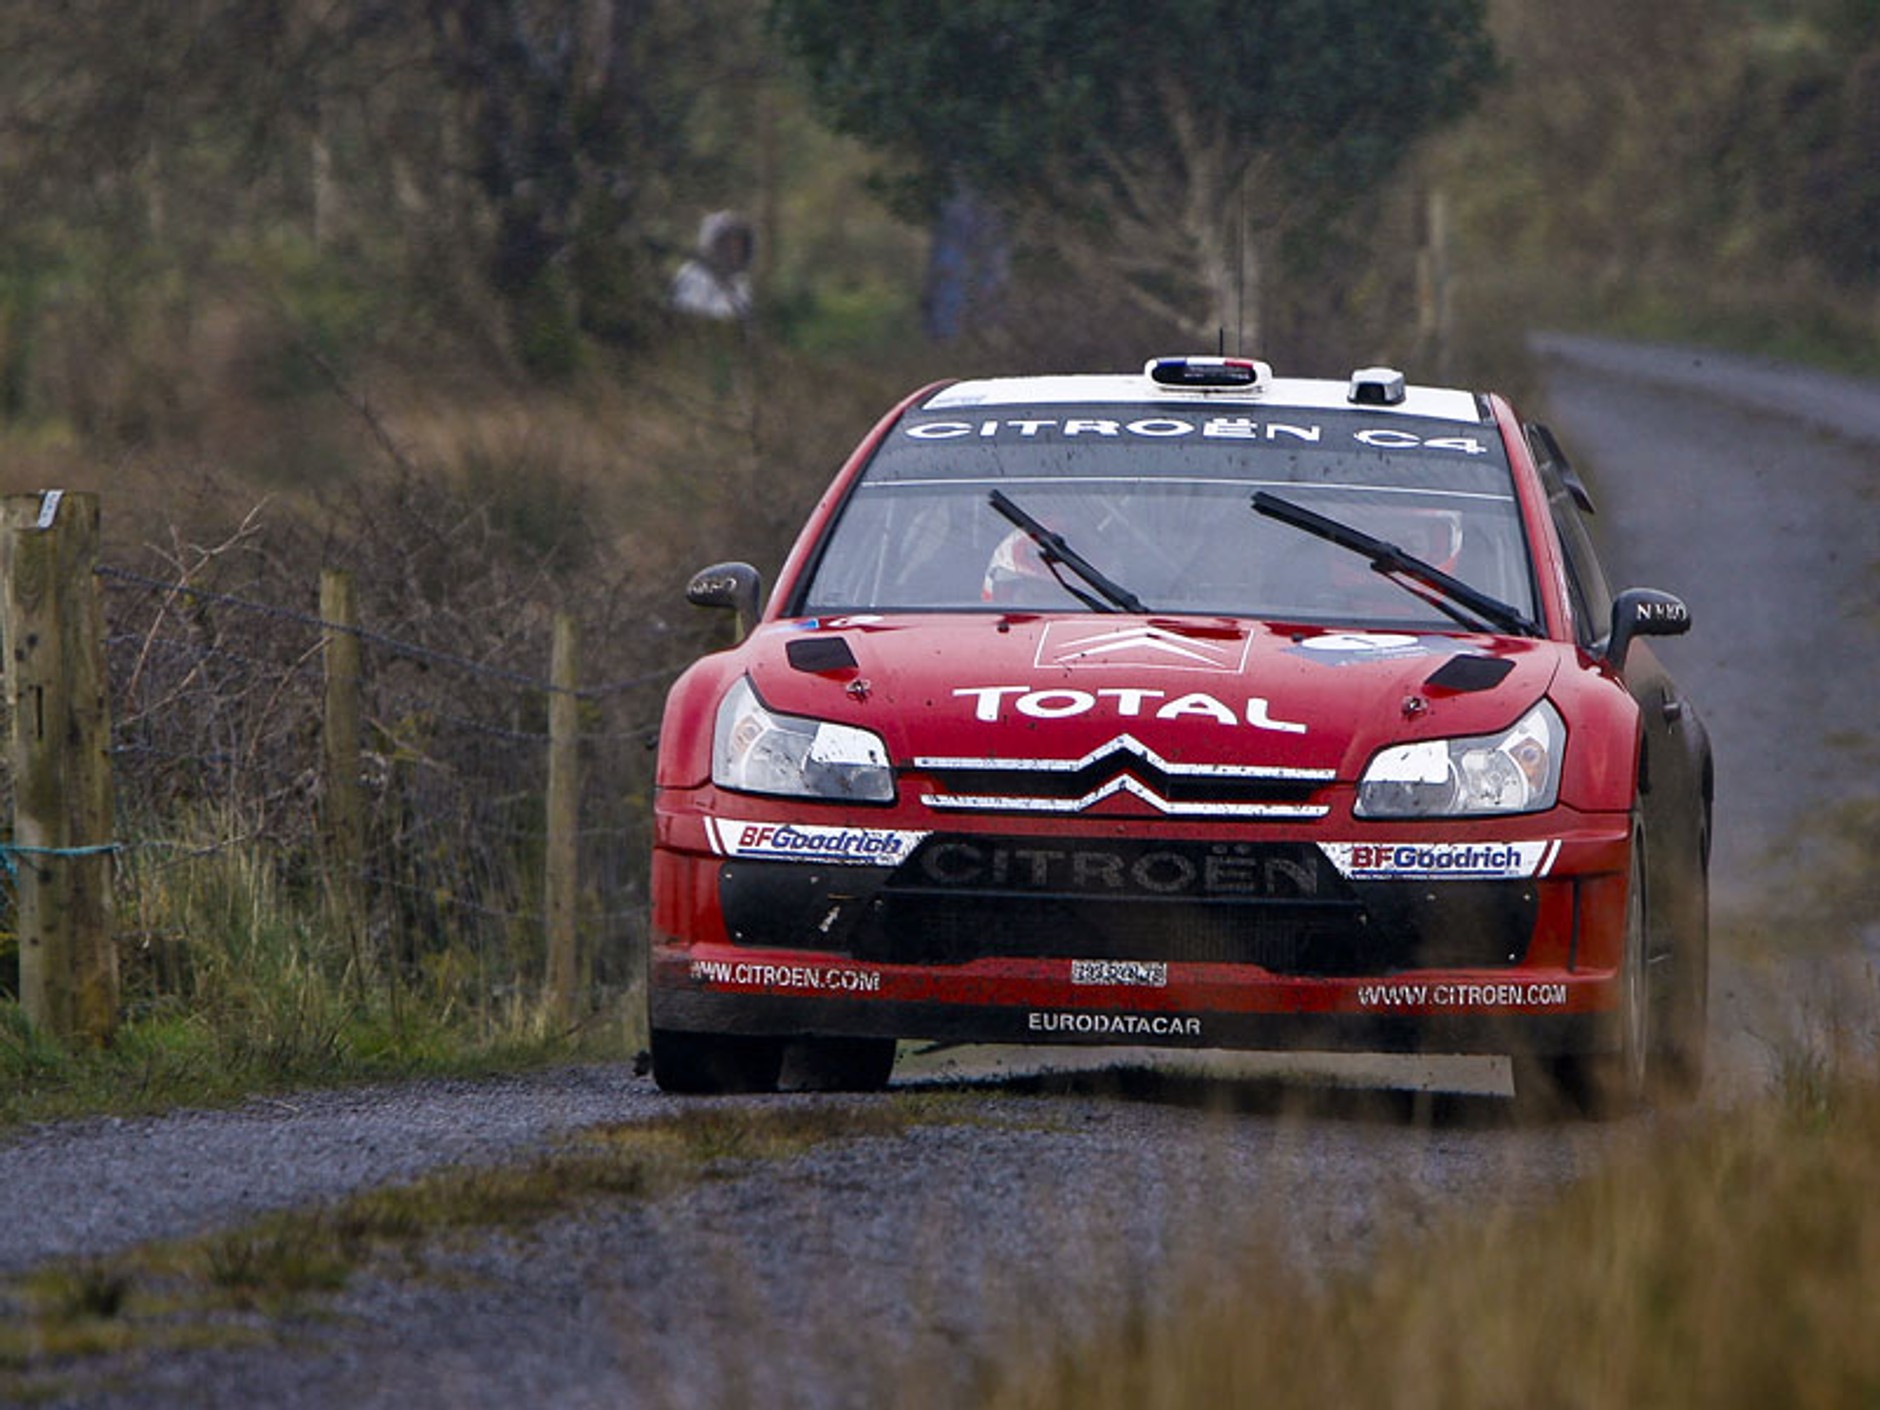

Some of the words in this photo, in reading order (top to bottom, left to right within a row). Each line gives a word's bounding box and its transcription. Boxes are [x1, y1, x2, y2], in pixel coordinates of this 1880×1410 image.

[1354, 429, 1487, 455] C4
[953, 686, 1307, 734] TOTAL
[738, 825, 903, 853] BFGoodrich
[922, 843, 1318, 894] CITROËN
[1351, 845, 1521, 869] BFGoodrich
[1028, 1013, 1201, 1035] EURODATACAR
